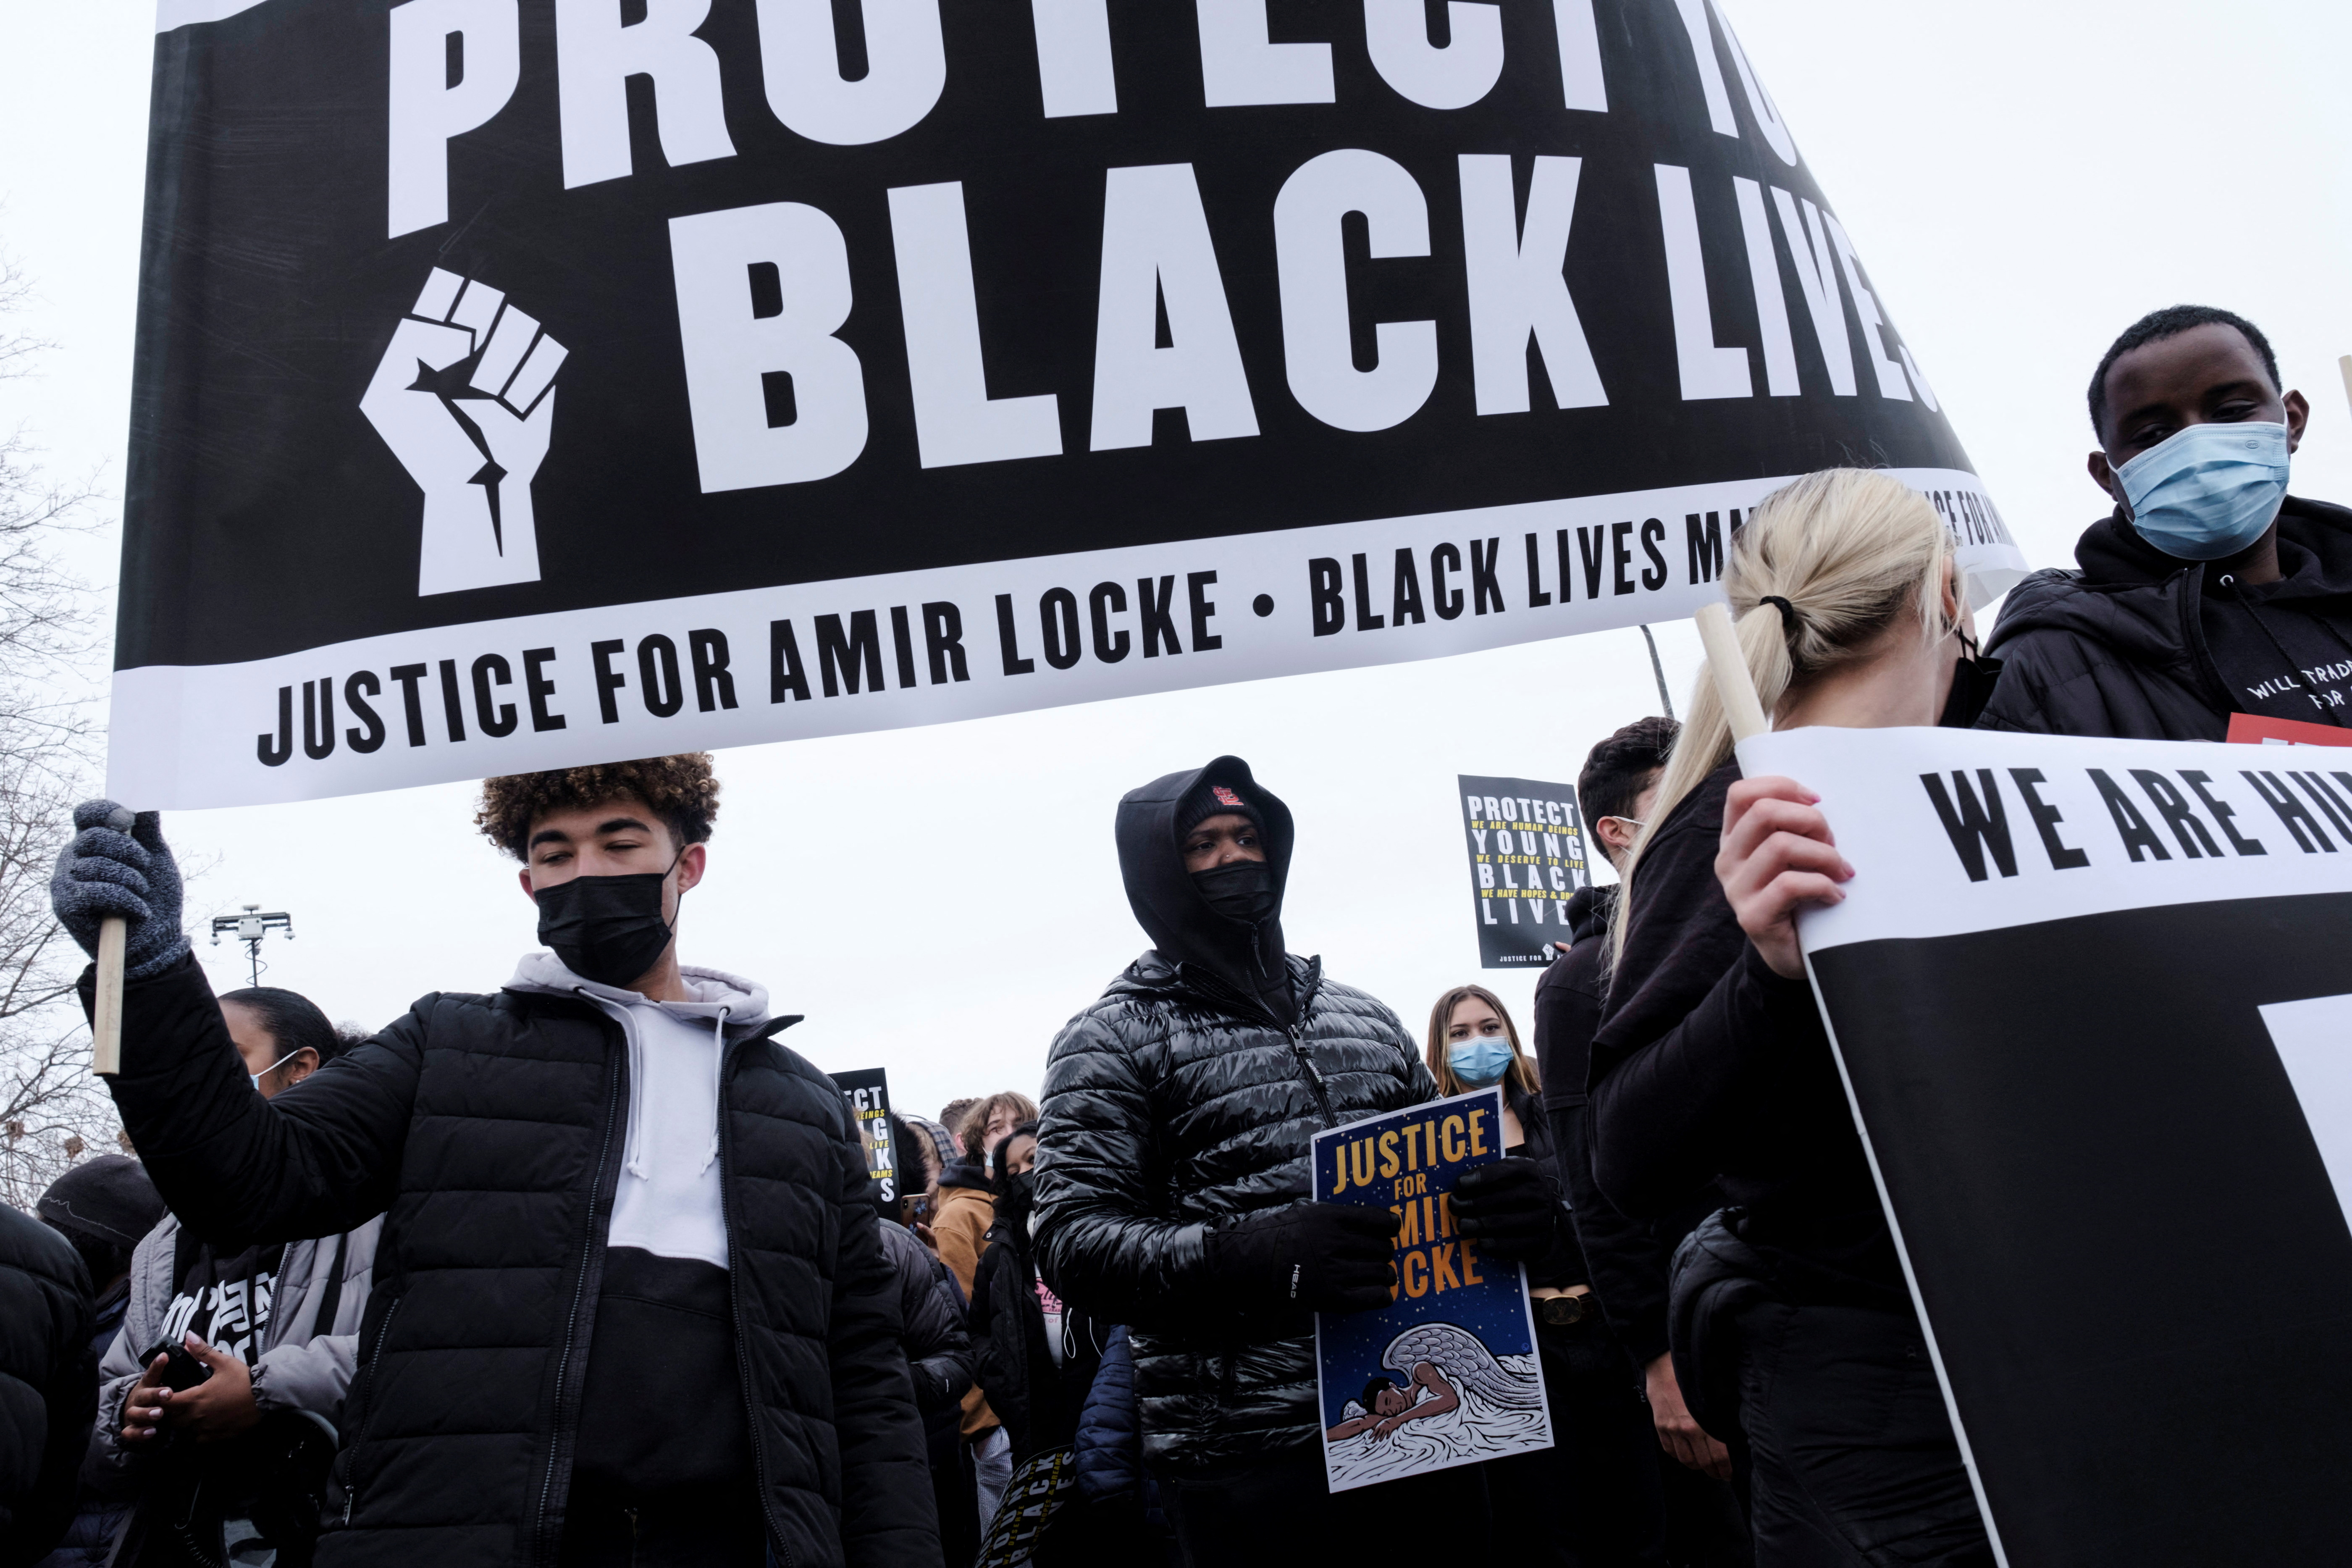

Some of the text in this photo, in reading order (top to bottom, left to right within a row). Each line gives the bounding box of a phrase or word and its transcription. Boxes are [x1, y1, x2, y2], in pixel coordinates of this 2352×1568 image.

[668, 148, 1610, 494] BLACK
[257, 646, 567, 767] JUSTICE
[591, 628, 740, 724] FOR
[770, 601, 971, 704] AMIR
[995, 570, 1222, 677] LOCKE
[1308, 537, 1506, 638] BLACK
[1525, 517, 1668, 608] LIVES
[1956, 490, 1995, 546] FOR
[2247, 675, 2301, 699] WILL
[1467, 796, 1574, 827] PROTECT
[1919, 768, 2091, 882] WE
[2084, 768, 2269, 862] ARE
[1471, 820, 1578, 836] WE ARE HUMAN BEINGS
[1471, 829, 1583, 860] YOUNG
[1476, 854, 1584, 869] WE DESERVE TO LIVE
[1477, 863, 1586, 891] BLACK
[1481, 889, 1494, 898] WE
[1497, 889, 1518, 898] HAVE
[1521, 890, 1547, 899] HOPES
[1550, 891, 1557, 899] &
[1482, 898, 1570, 925] LIVE
[857, 1108, 885, 1120] EINGS
[869, 1139, 889, 1150] LIVE
[1333, 1108, 1488, 1195] JUSTICE
[870, 1169, 893, 1179] EAMS
[1394, 1173, 1428, 1200] FOR
[1389, 1192, 1460, 1250] MIR
[1290, 1264, 1301, 1298] HEAD
[1387, 1237, 1484, 1302] CKE
[1050, 1453, 1063, 1485] DREAMS
[1009, 1453, 1057, 1564] BLACK
[1008, 1505, 1025, 1546] DESERVE
